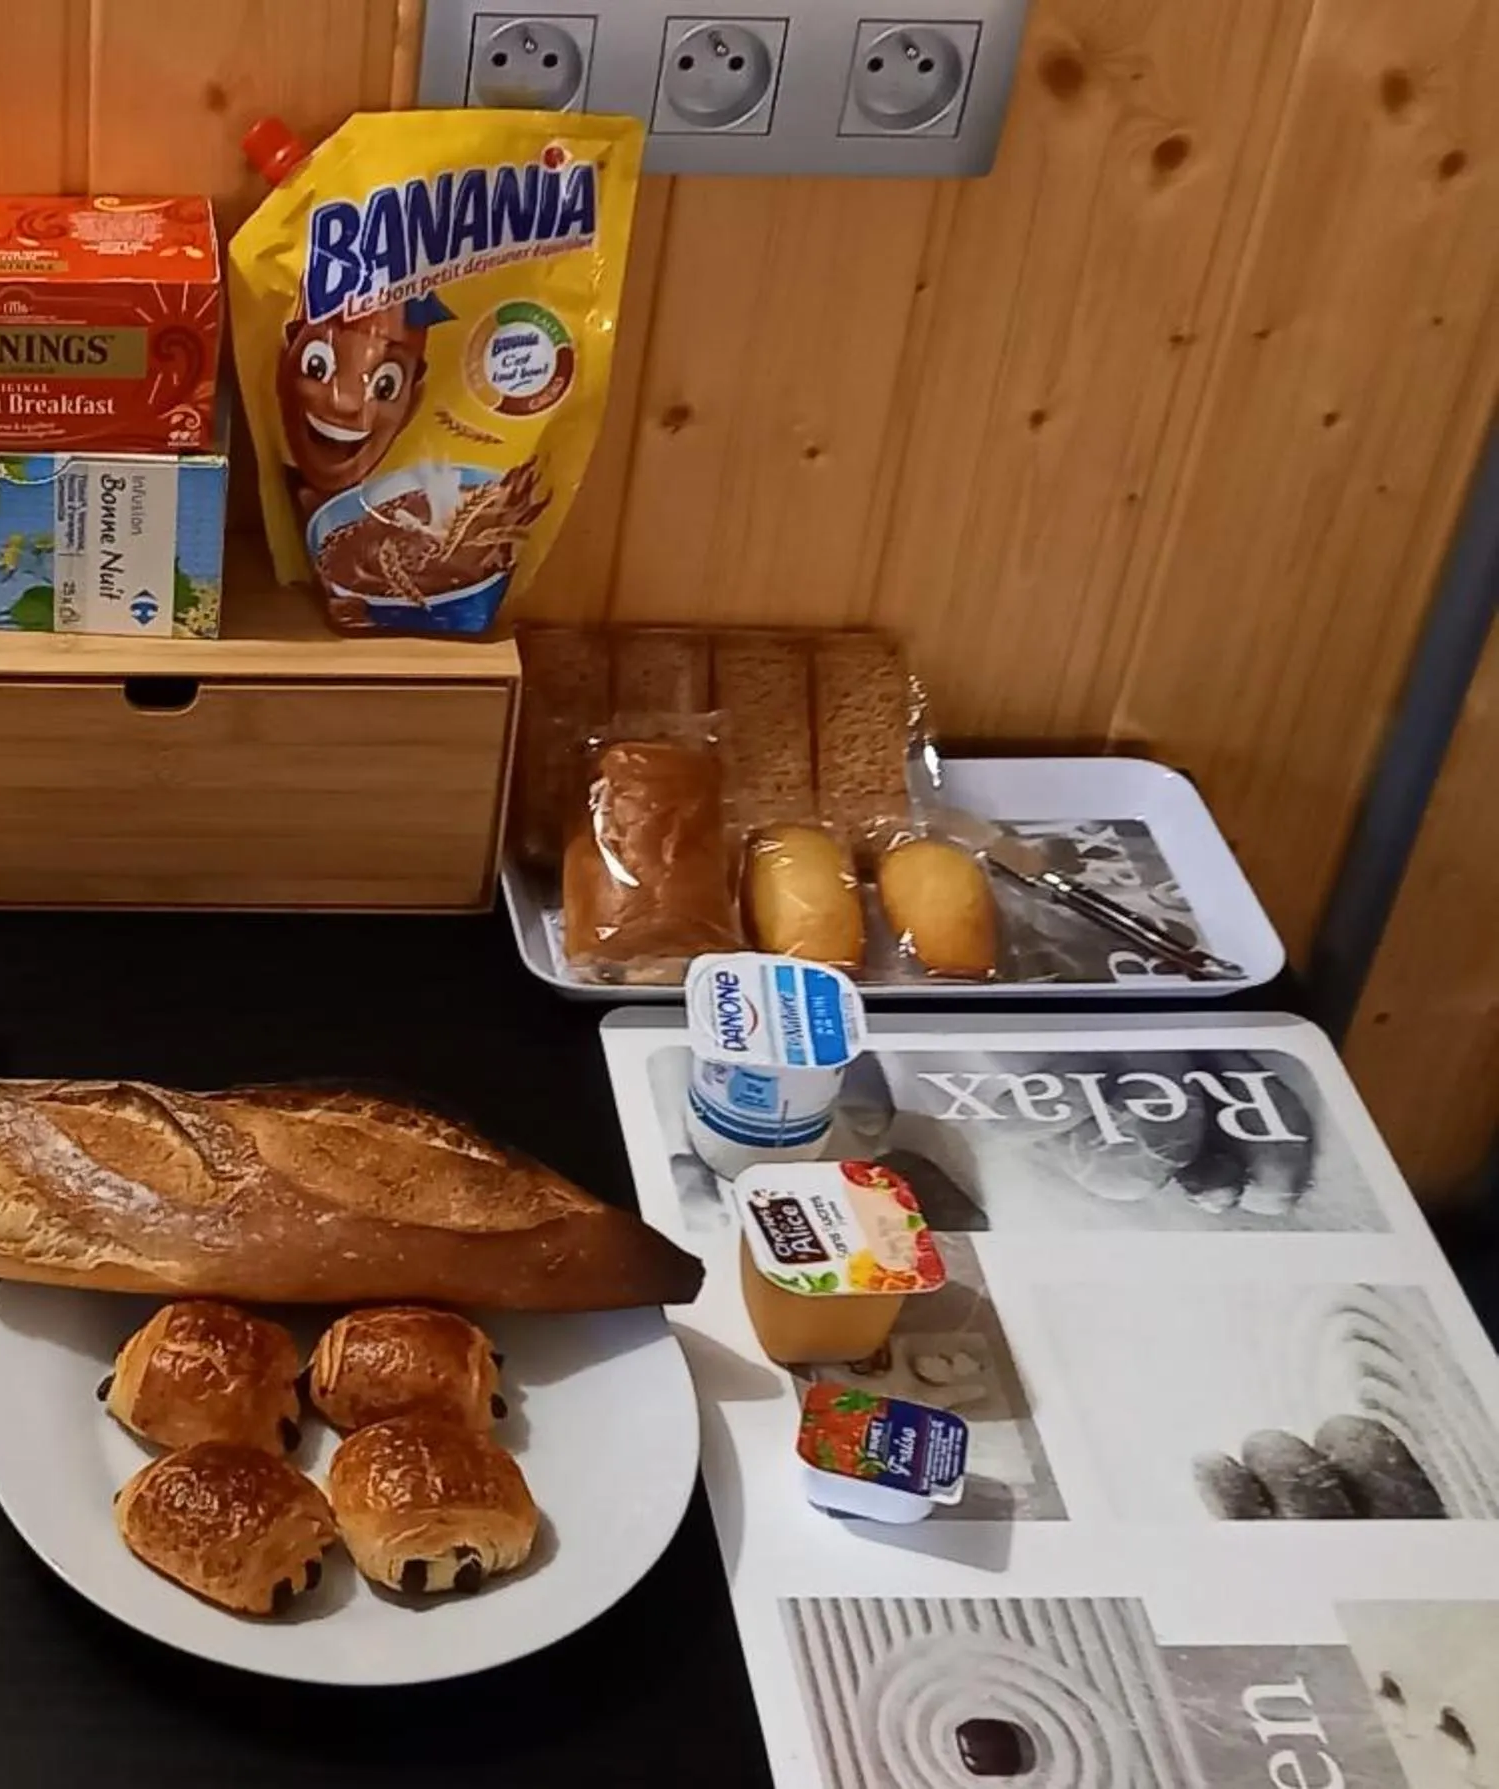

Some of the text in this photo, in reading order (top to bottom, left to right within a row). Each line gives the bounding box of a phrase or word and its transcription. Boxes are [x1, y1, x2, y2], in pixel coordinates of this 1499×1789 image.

[9, 393, 116, 415] Breakfast
[99, 474, 126, 601] Bonne Nuit
[130, 475, 146, 536] Infusion
[917, 1069, 1310, 1147] Relax
[1241, 1675, 1346, 1789] en
